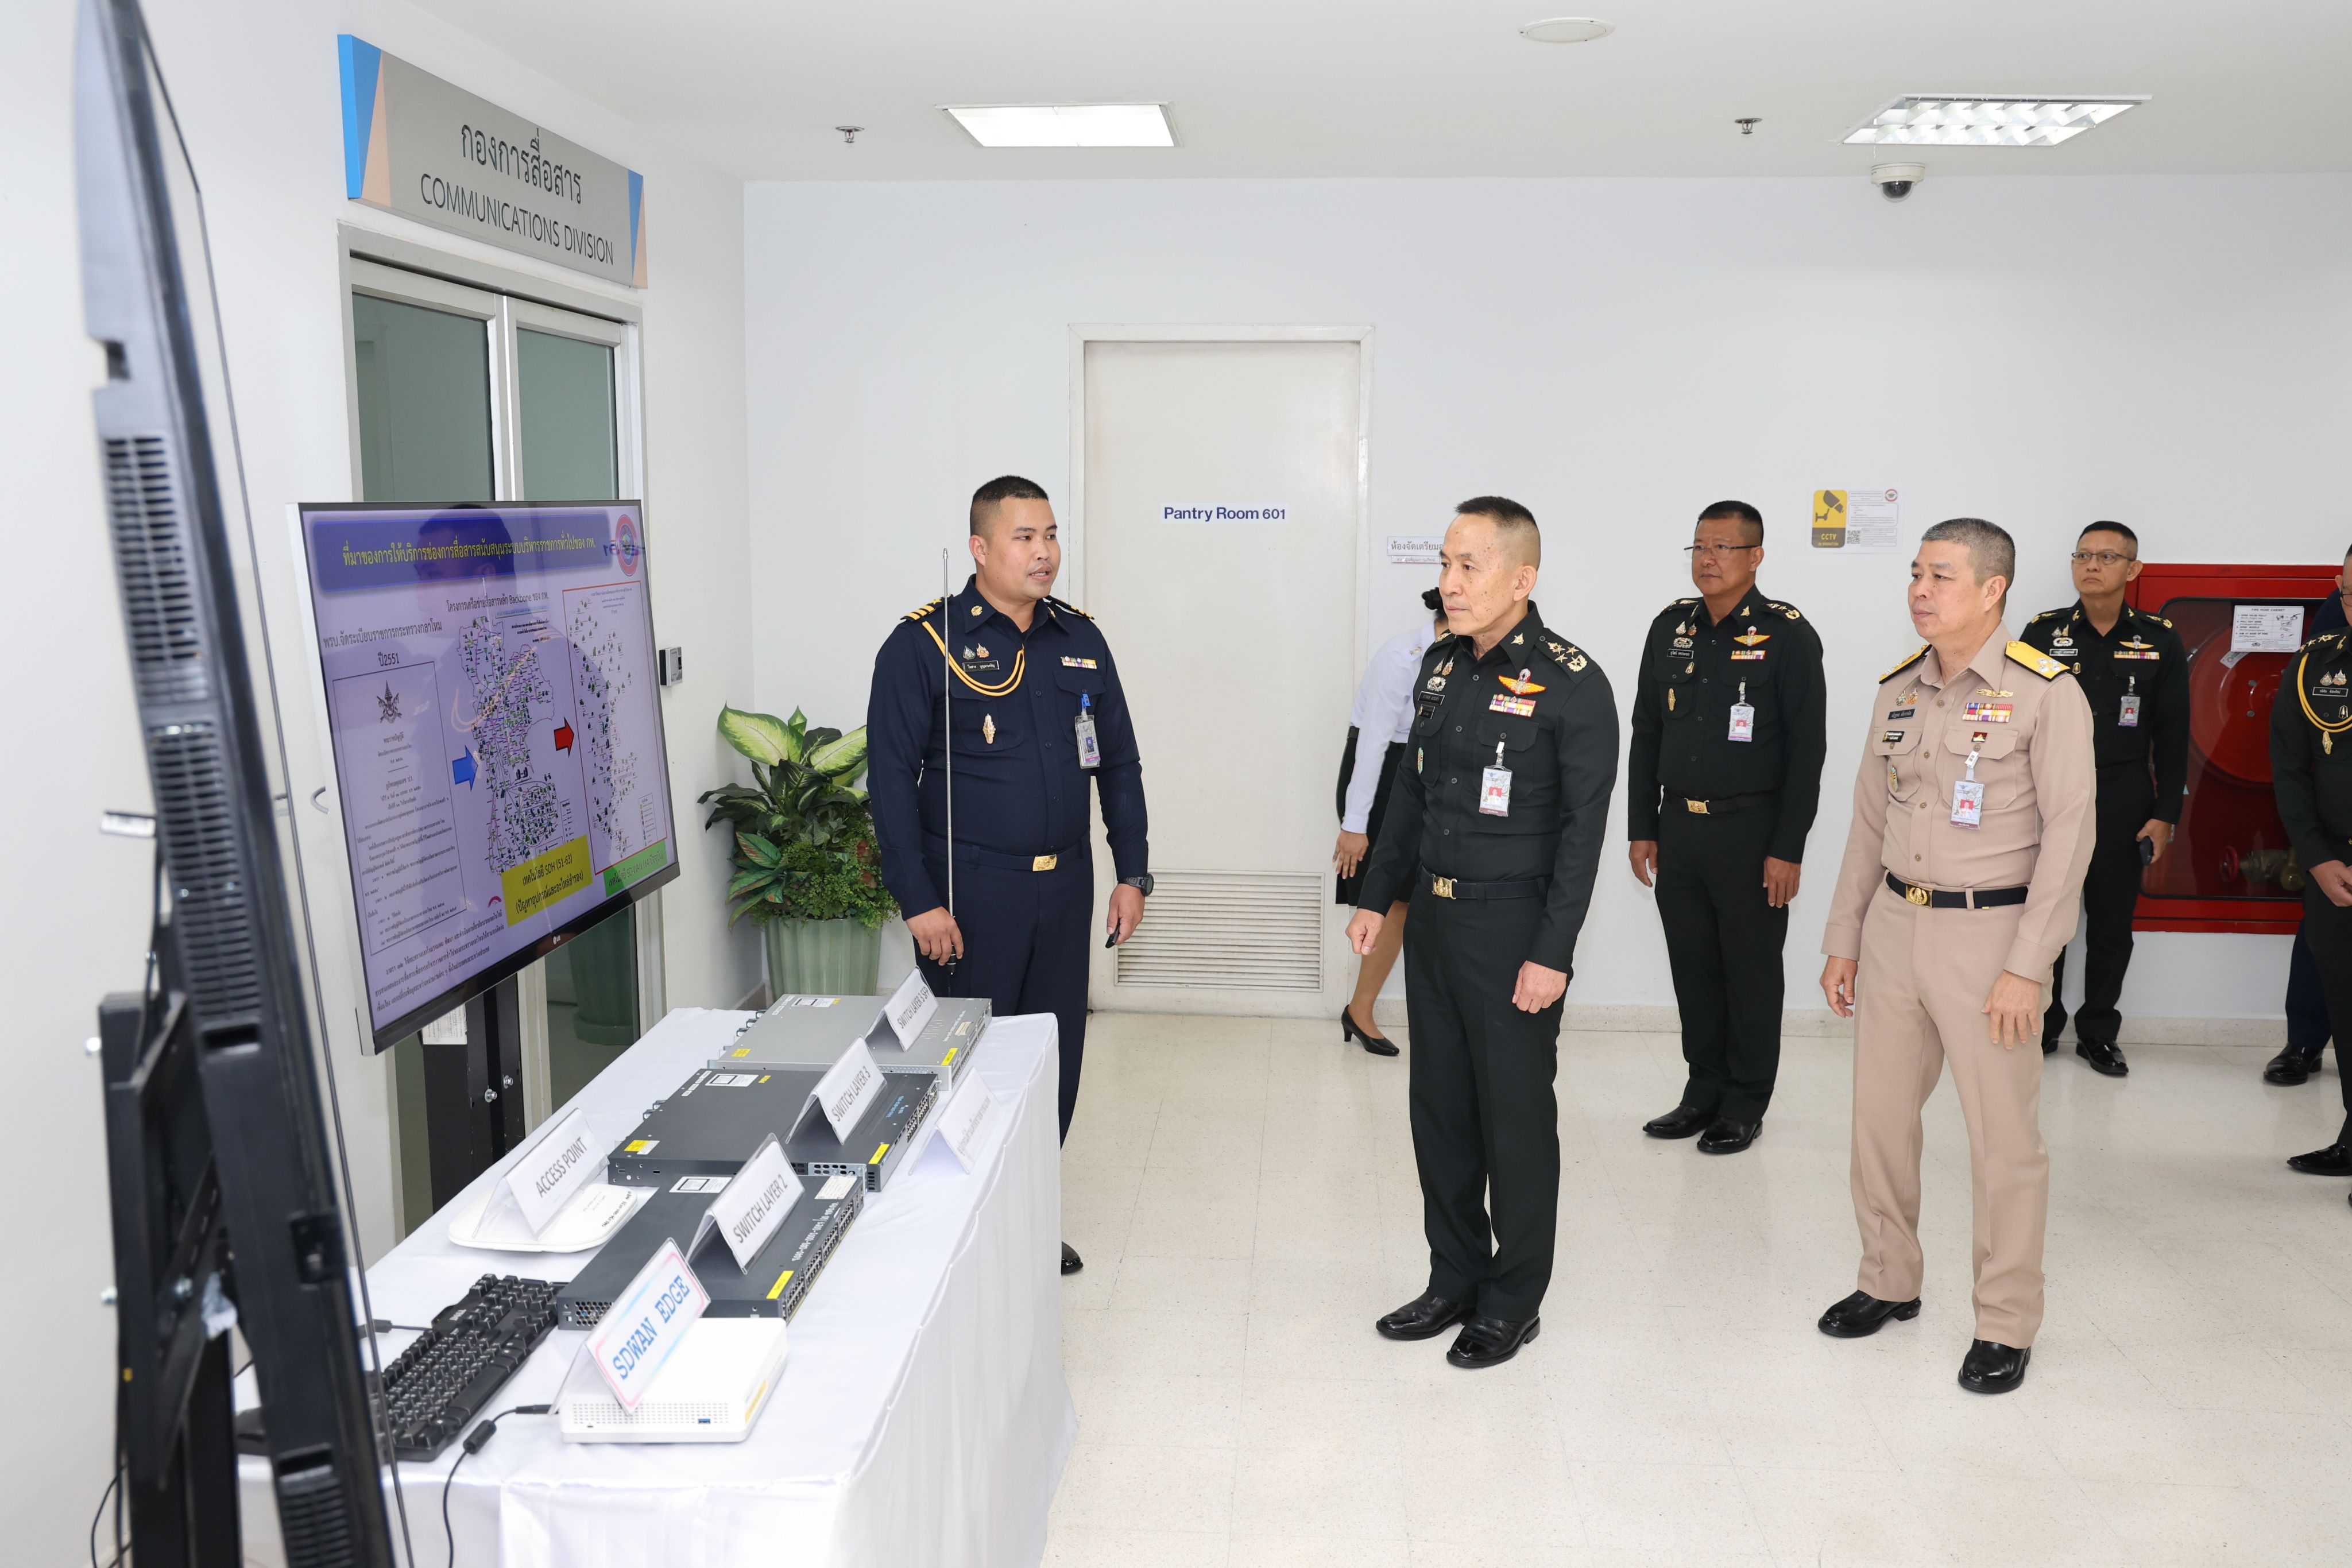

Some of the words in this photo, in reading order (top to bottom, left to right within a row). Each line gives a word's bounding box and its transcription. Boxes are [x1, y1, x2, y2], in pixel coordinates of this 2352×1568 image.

[461, 124, 582, 204] กองการสื่อสาร
[420, 173, 560, 247] COMMUNICATIONS
[564, 224, 614, 266] DIVISION
[1164, 506, 1213, 522] Pantry
[1216, 506, 1259, 520] Room
[1262, 508, 1286, 520] 601
[509, 594, 532, 605] Backbone
[378, 652, 400, 667] ปี2551
[523, 866, 544, 885] เทคโนโลยี
[545, 862, 555, 876] SDH
[556, 852, 573, 872] (51-63)
[897, 1008, 912, 1029] SWITCH
[911, 996, 922, 1014] LAYER
[919, 993, 925, 1002] 3
[831, 1090, 852, 1122] SWITCH
[852, 1071, 868, 1096] LAYER
[863, 1066, 871, 1078] 3
[535, 1159, 566, 1198] ACCESS
[562, 1137, 588, 1168] POINT
[733, 1203, 764, 1244] SWITCH
[763, 1179, 782, 1211] LAYER
[779, 1174, 788, 1190] 2
[613, 1317, 658, 1380] SDWAN
[655, 1275, 691, 1323] EDGE
